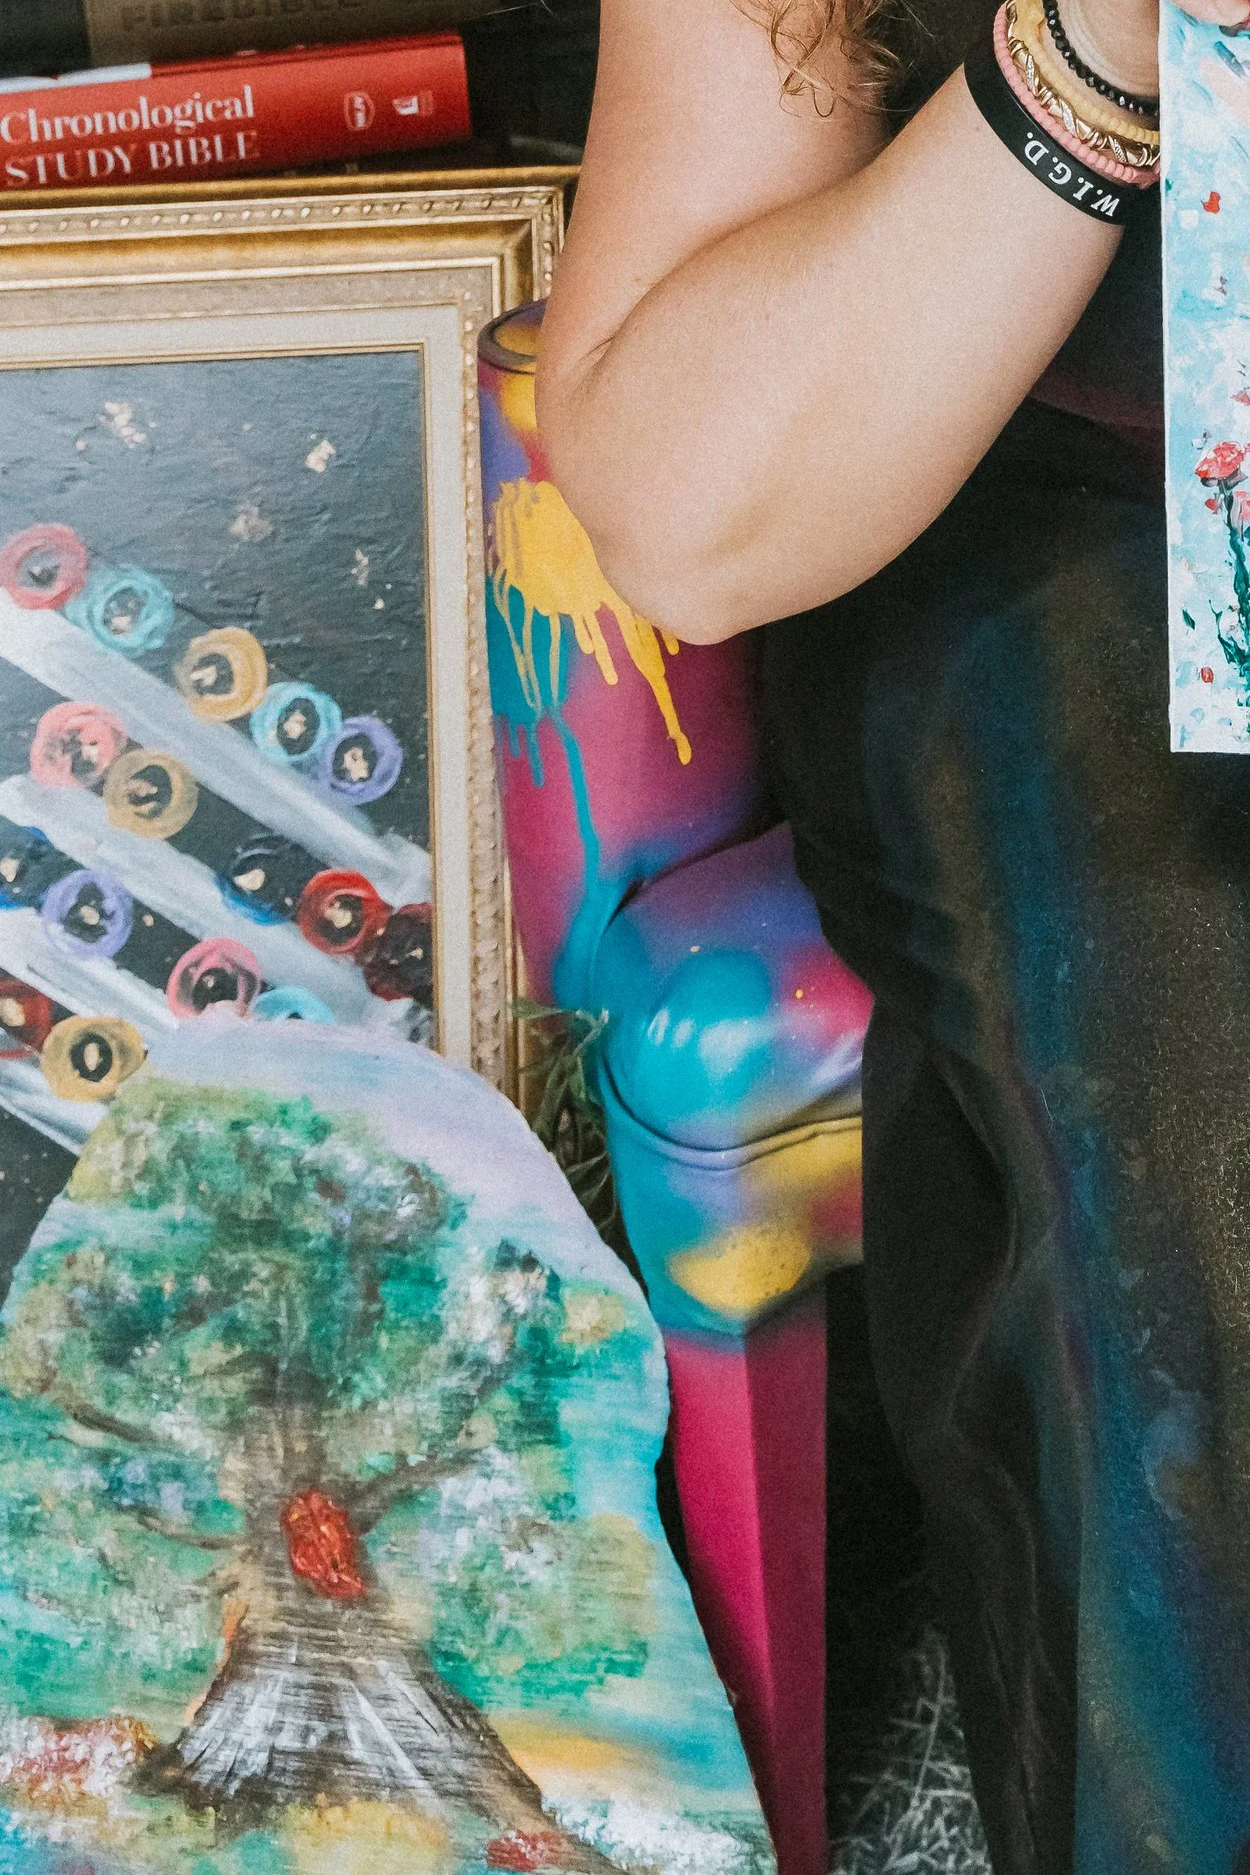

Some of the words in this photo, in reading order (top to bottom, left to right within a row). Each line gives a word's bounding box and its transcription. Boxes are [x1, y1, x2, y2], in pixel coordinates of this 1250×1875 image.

[0, 83, 255, 145] Chronological
[5, 143, 137, 187] STUDY
[149, 130, 260, 170] BIBLE
[1023, 131, 1120, 217] W.I.G.D.
